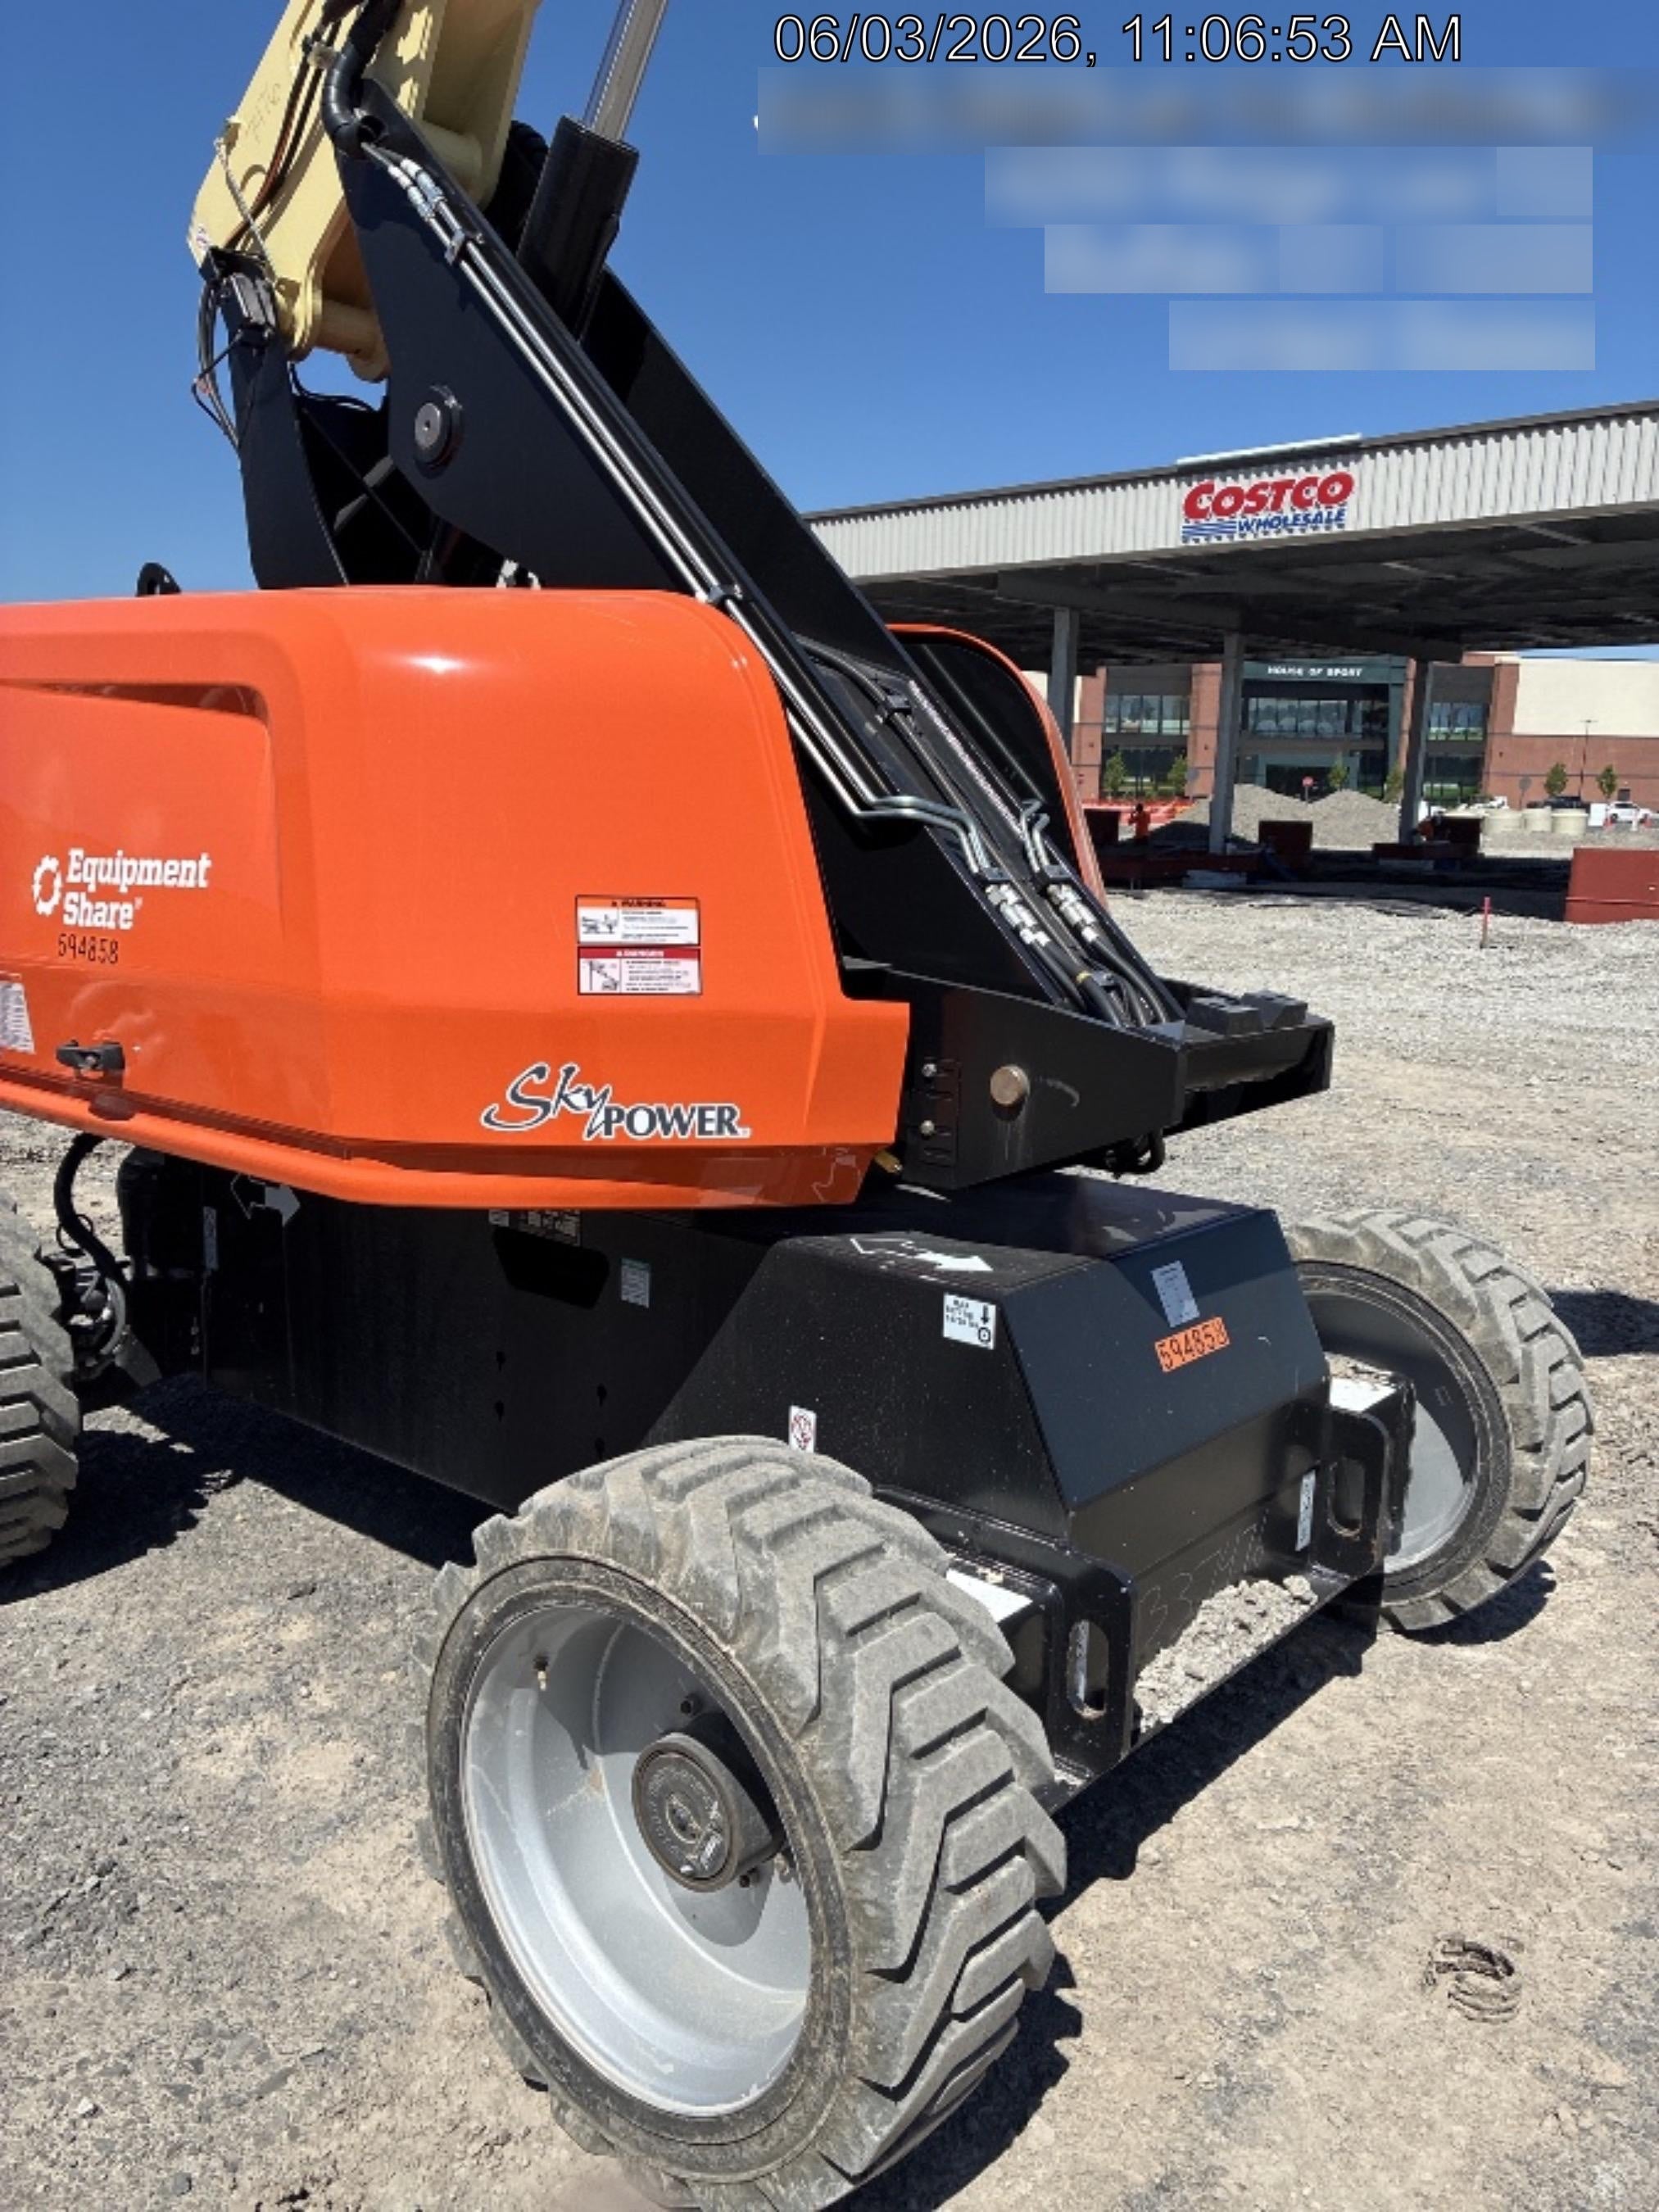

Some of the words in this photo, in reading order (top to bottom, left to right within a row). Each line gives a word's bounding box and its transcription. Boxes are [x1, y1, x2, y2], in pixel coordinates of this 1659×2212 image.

[1183, 472, 1354, 519] COSTCO
[1238, 508, 1346, 532] WHOLESALE
[66, 847, 211, 893] Equipment
[63, 891, 134, 930] Share
[57, 932, 119, 965] 594858
[1157, 1318, 1228, 1371] 594858
